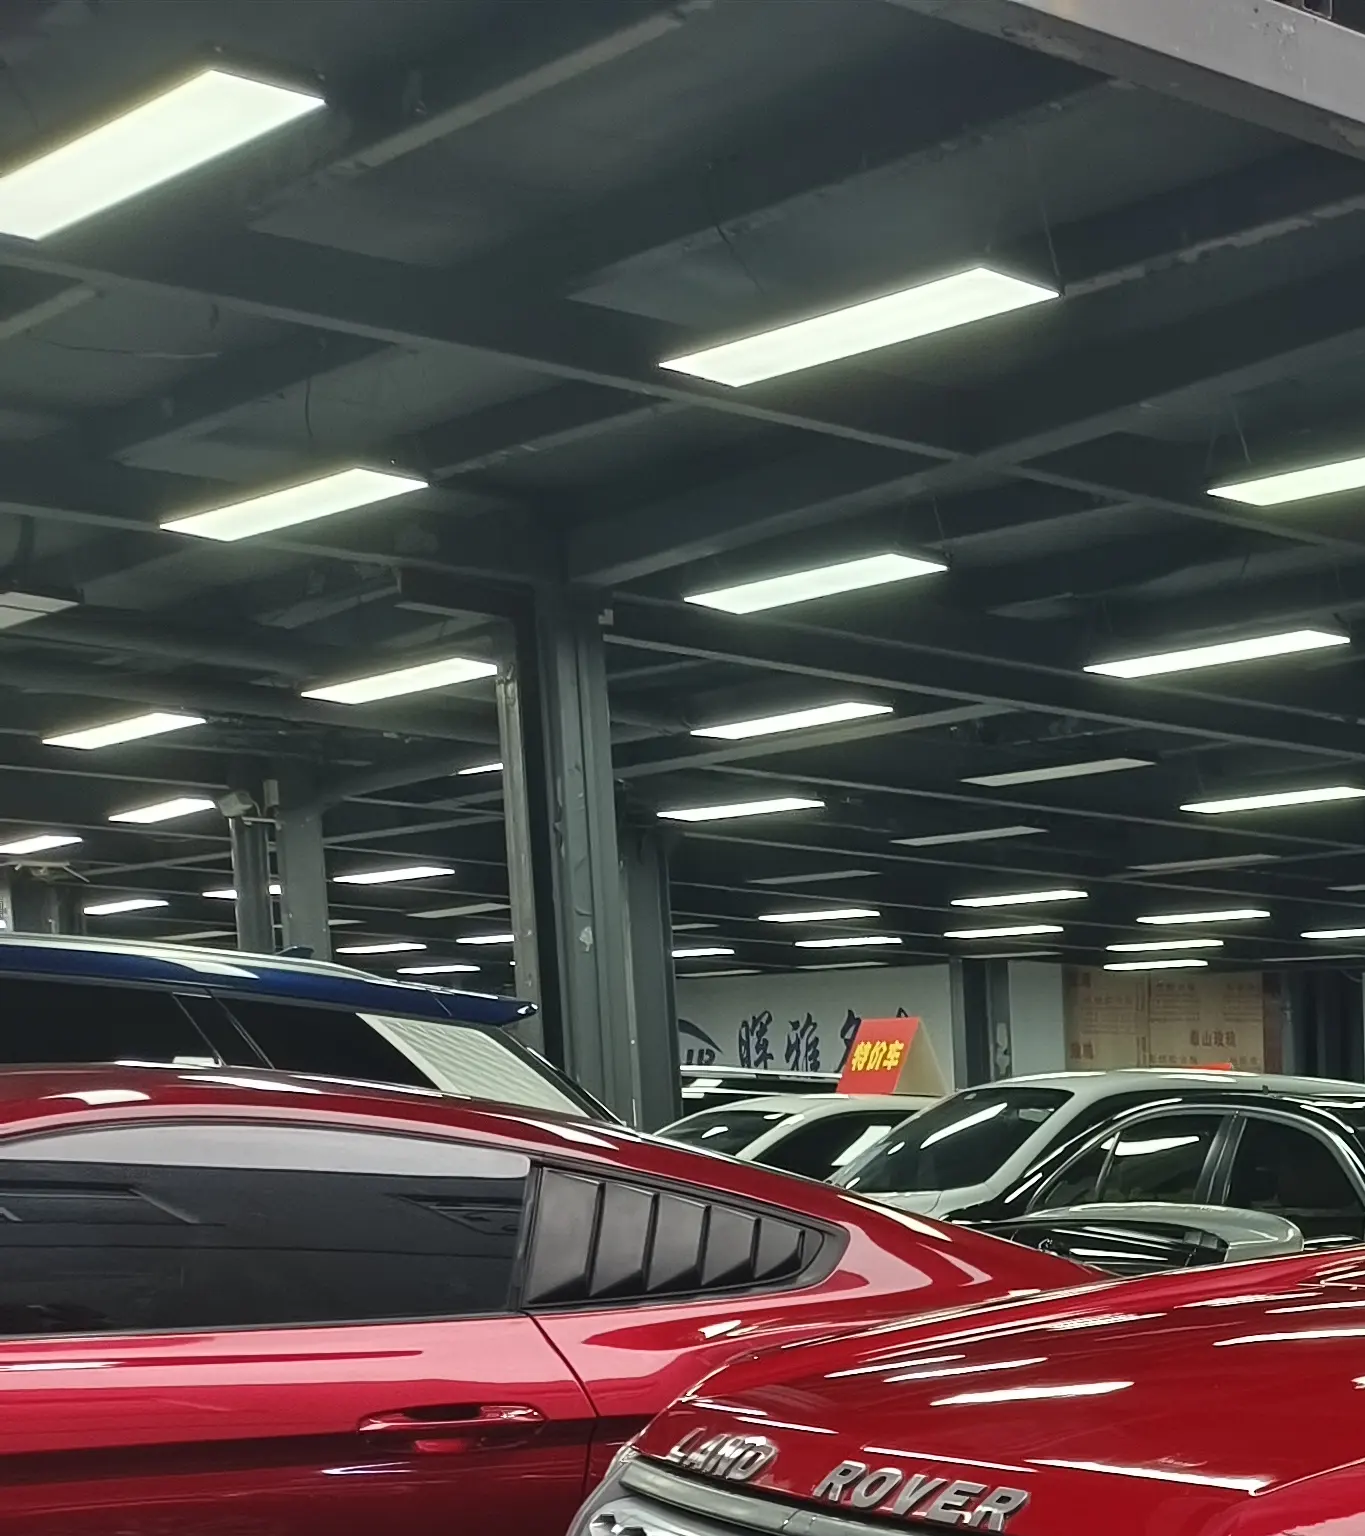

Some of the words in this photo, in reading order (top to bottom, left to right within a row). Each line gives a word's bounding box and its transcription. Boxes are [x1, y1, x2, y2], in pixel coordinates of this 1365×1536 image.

[851, 1040, 905, 1071] 特价车
[665, 1427, 779, 1481] LAND
[812, 1460, 1031, 1532] ROVER
